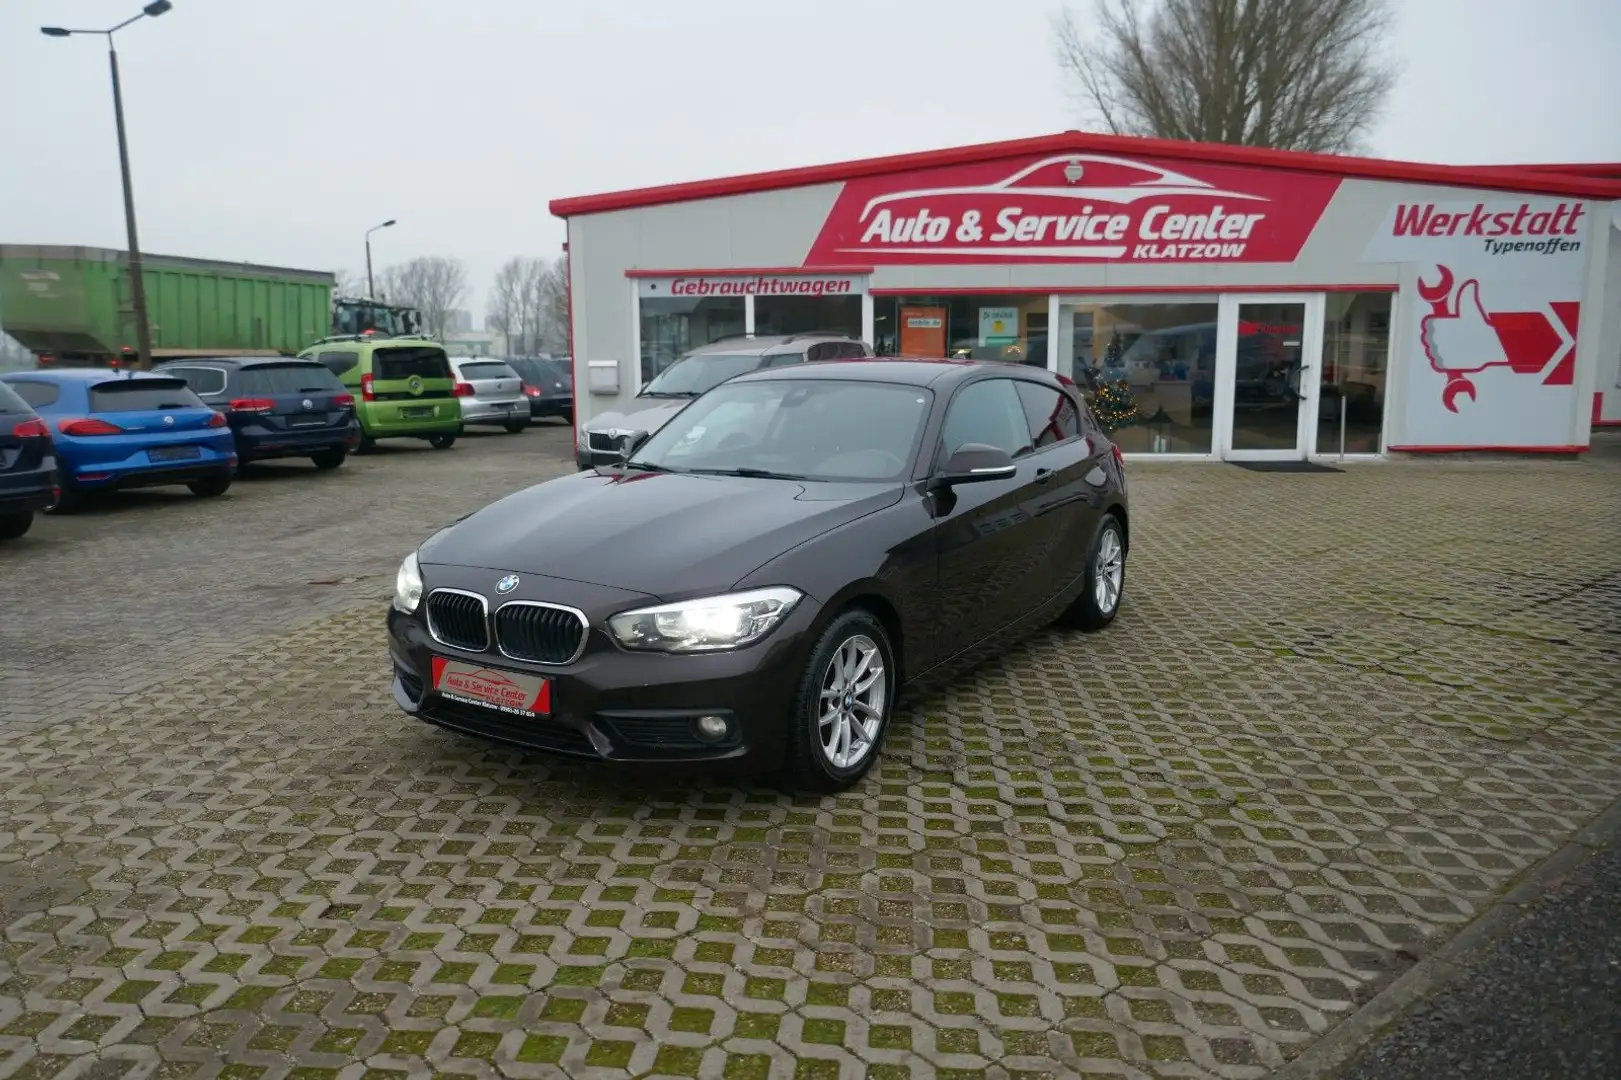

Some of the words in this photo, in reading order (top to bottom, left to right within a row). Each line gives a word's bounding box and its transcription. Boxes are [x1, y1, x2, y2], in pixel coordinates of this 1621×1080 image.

[861, 208, 951, 243] Auto
[955, 212, 983, 242] &
[989, 204, 1130, 242] Service
[1138, 204, 1266, 241] Center
[1392, 203, 1586, 237] Werkstatt
[1132, 243, 1246, 260] KLATZOW
[1484, 237, 1581, 255] Typenoffen
[670, 276, 852, 297] Gebrauchtwagen
[447, 676, 463, 687] Auto
[472, 681, 499, 693] Service
[500, 687, 527, 700] Center
